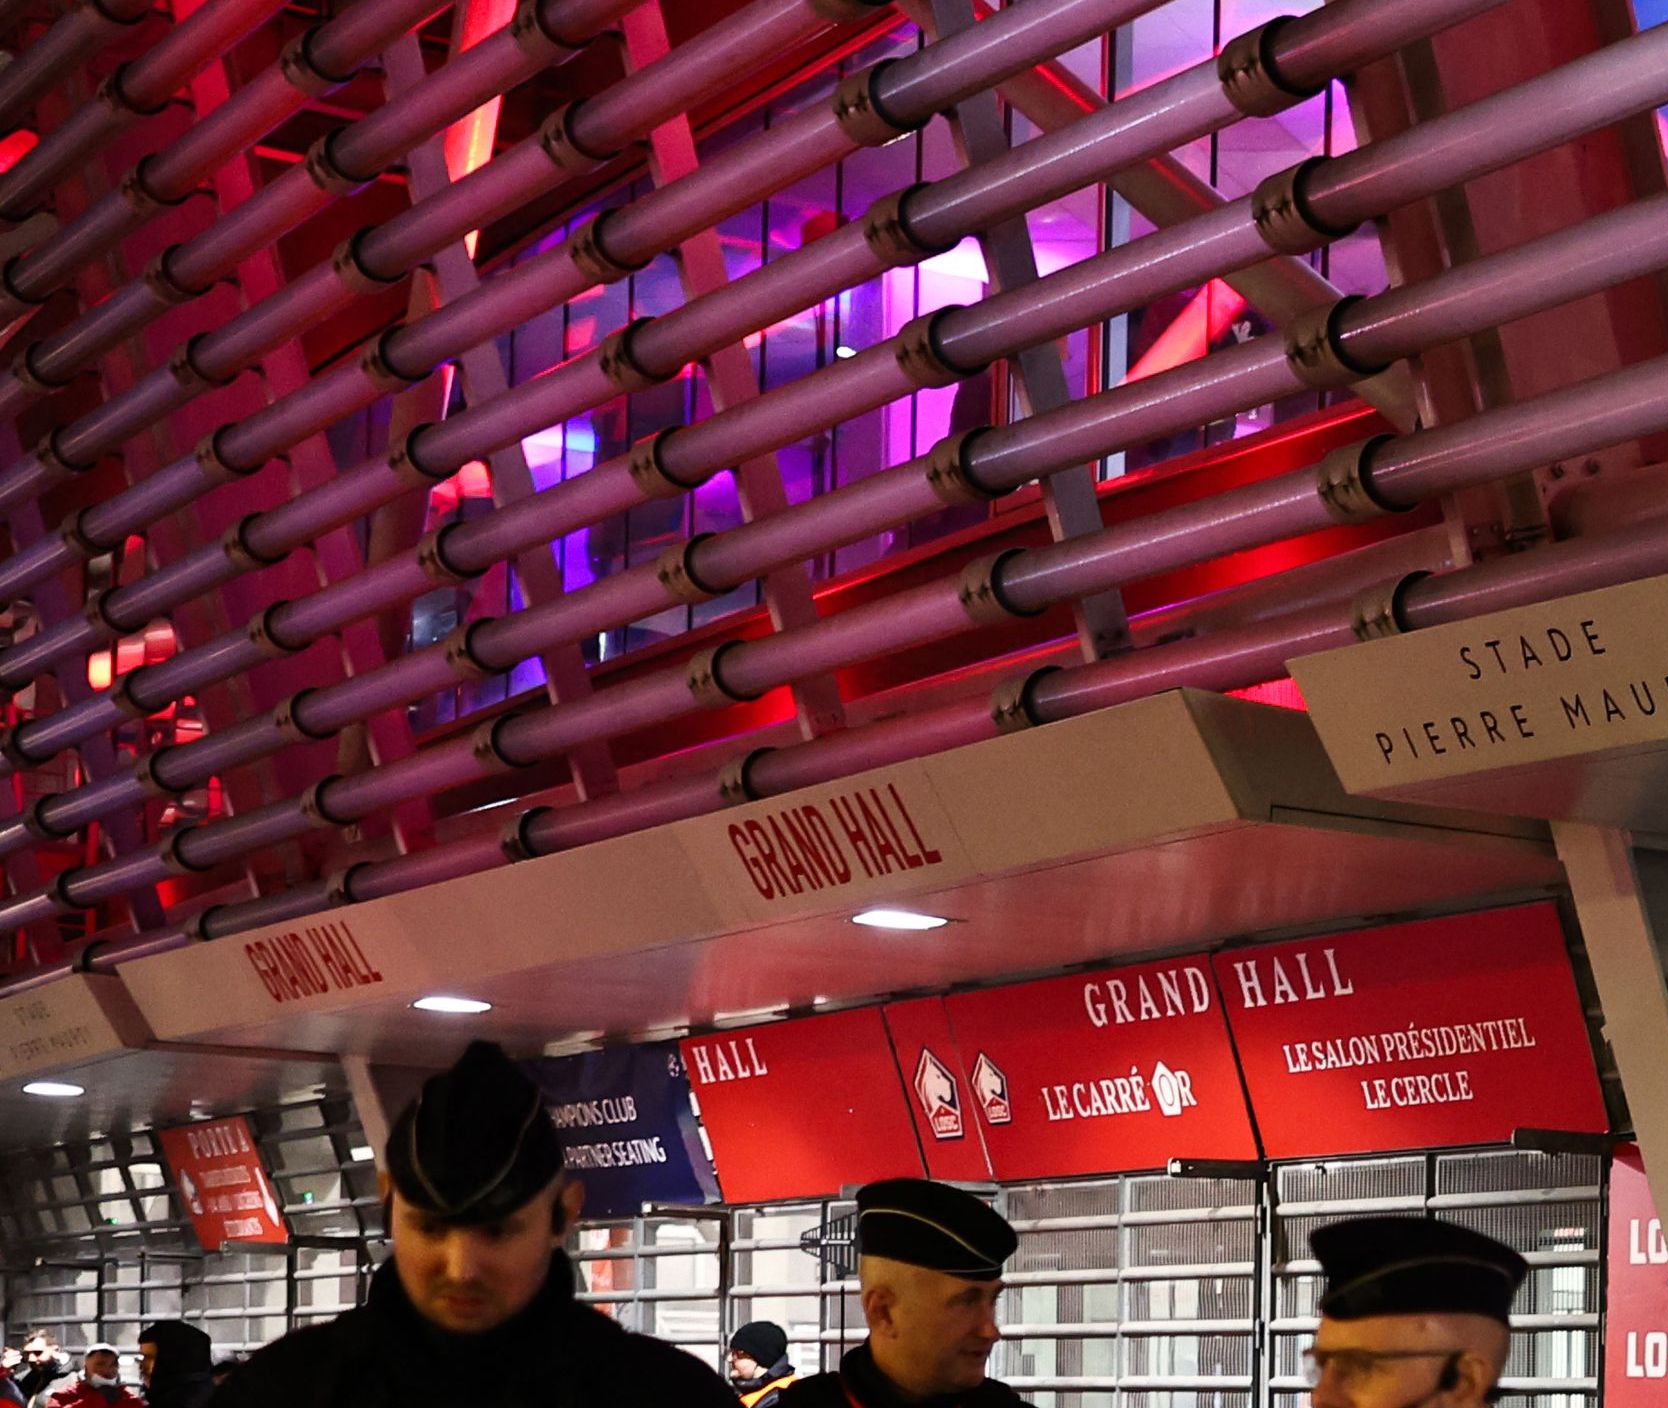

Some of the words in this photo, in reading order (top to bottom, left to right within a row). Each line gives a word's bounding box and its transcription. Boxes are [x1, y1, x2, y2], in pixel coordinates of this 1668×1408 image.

[1459, 619, 1608, 681] STADE
[1376, 703, 1535, 765] PIERRE
[728, 804, 851, 900] GRAND
[829, 783, 942, 878] HALL
[245, 933, 329, 1002] GRAND
[305, 920, 383, 990] HALL
[1084, 966, 1211, 1028] GRAND
[1233, 947, 1354, 1009] HALL
[691, 1038, 768, 1084] HALL
[1282, 1042, 1312, 1074] LE
[1311, 1033, 1381, 1070] SALON
[1384, 1017, 1536, 1063] PRÉSIDENTIEL
[603, 1095, 638, 1125] CLUB
[1041, 1085, 1074, 1121] LE
[1073, 1065, 1151, 1118] CARRÉ
[1361, 1079, 1390, 1110] LE
[1388, 1071, 1474, 1106] CERCLE
[934, 1113, 960, 1133] LOSC
[614, 1136, 667, 1167] SEATING
[1629, 1218, 1668, 1265] LO
